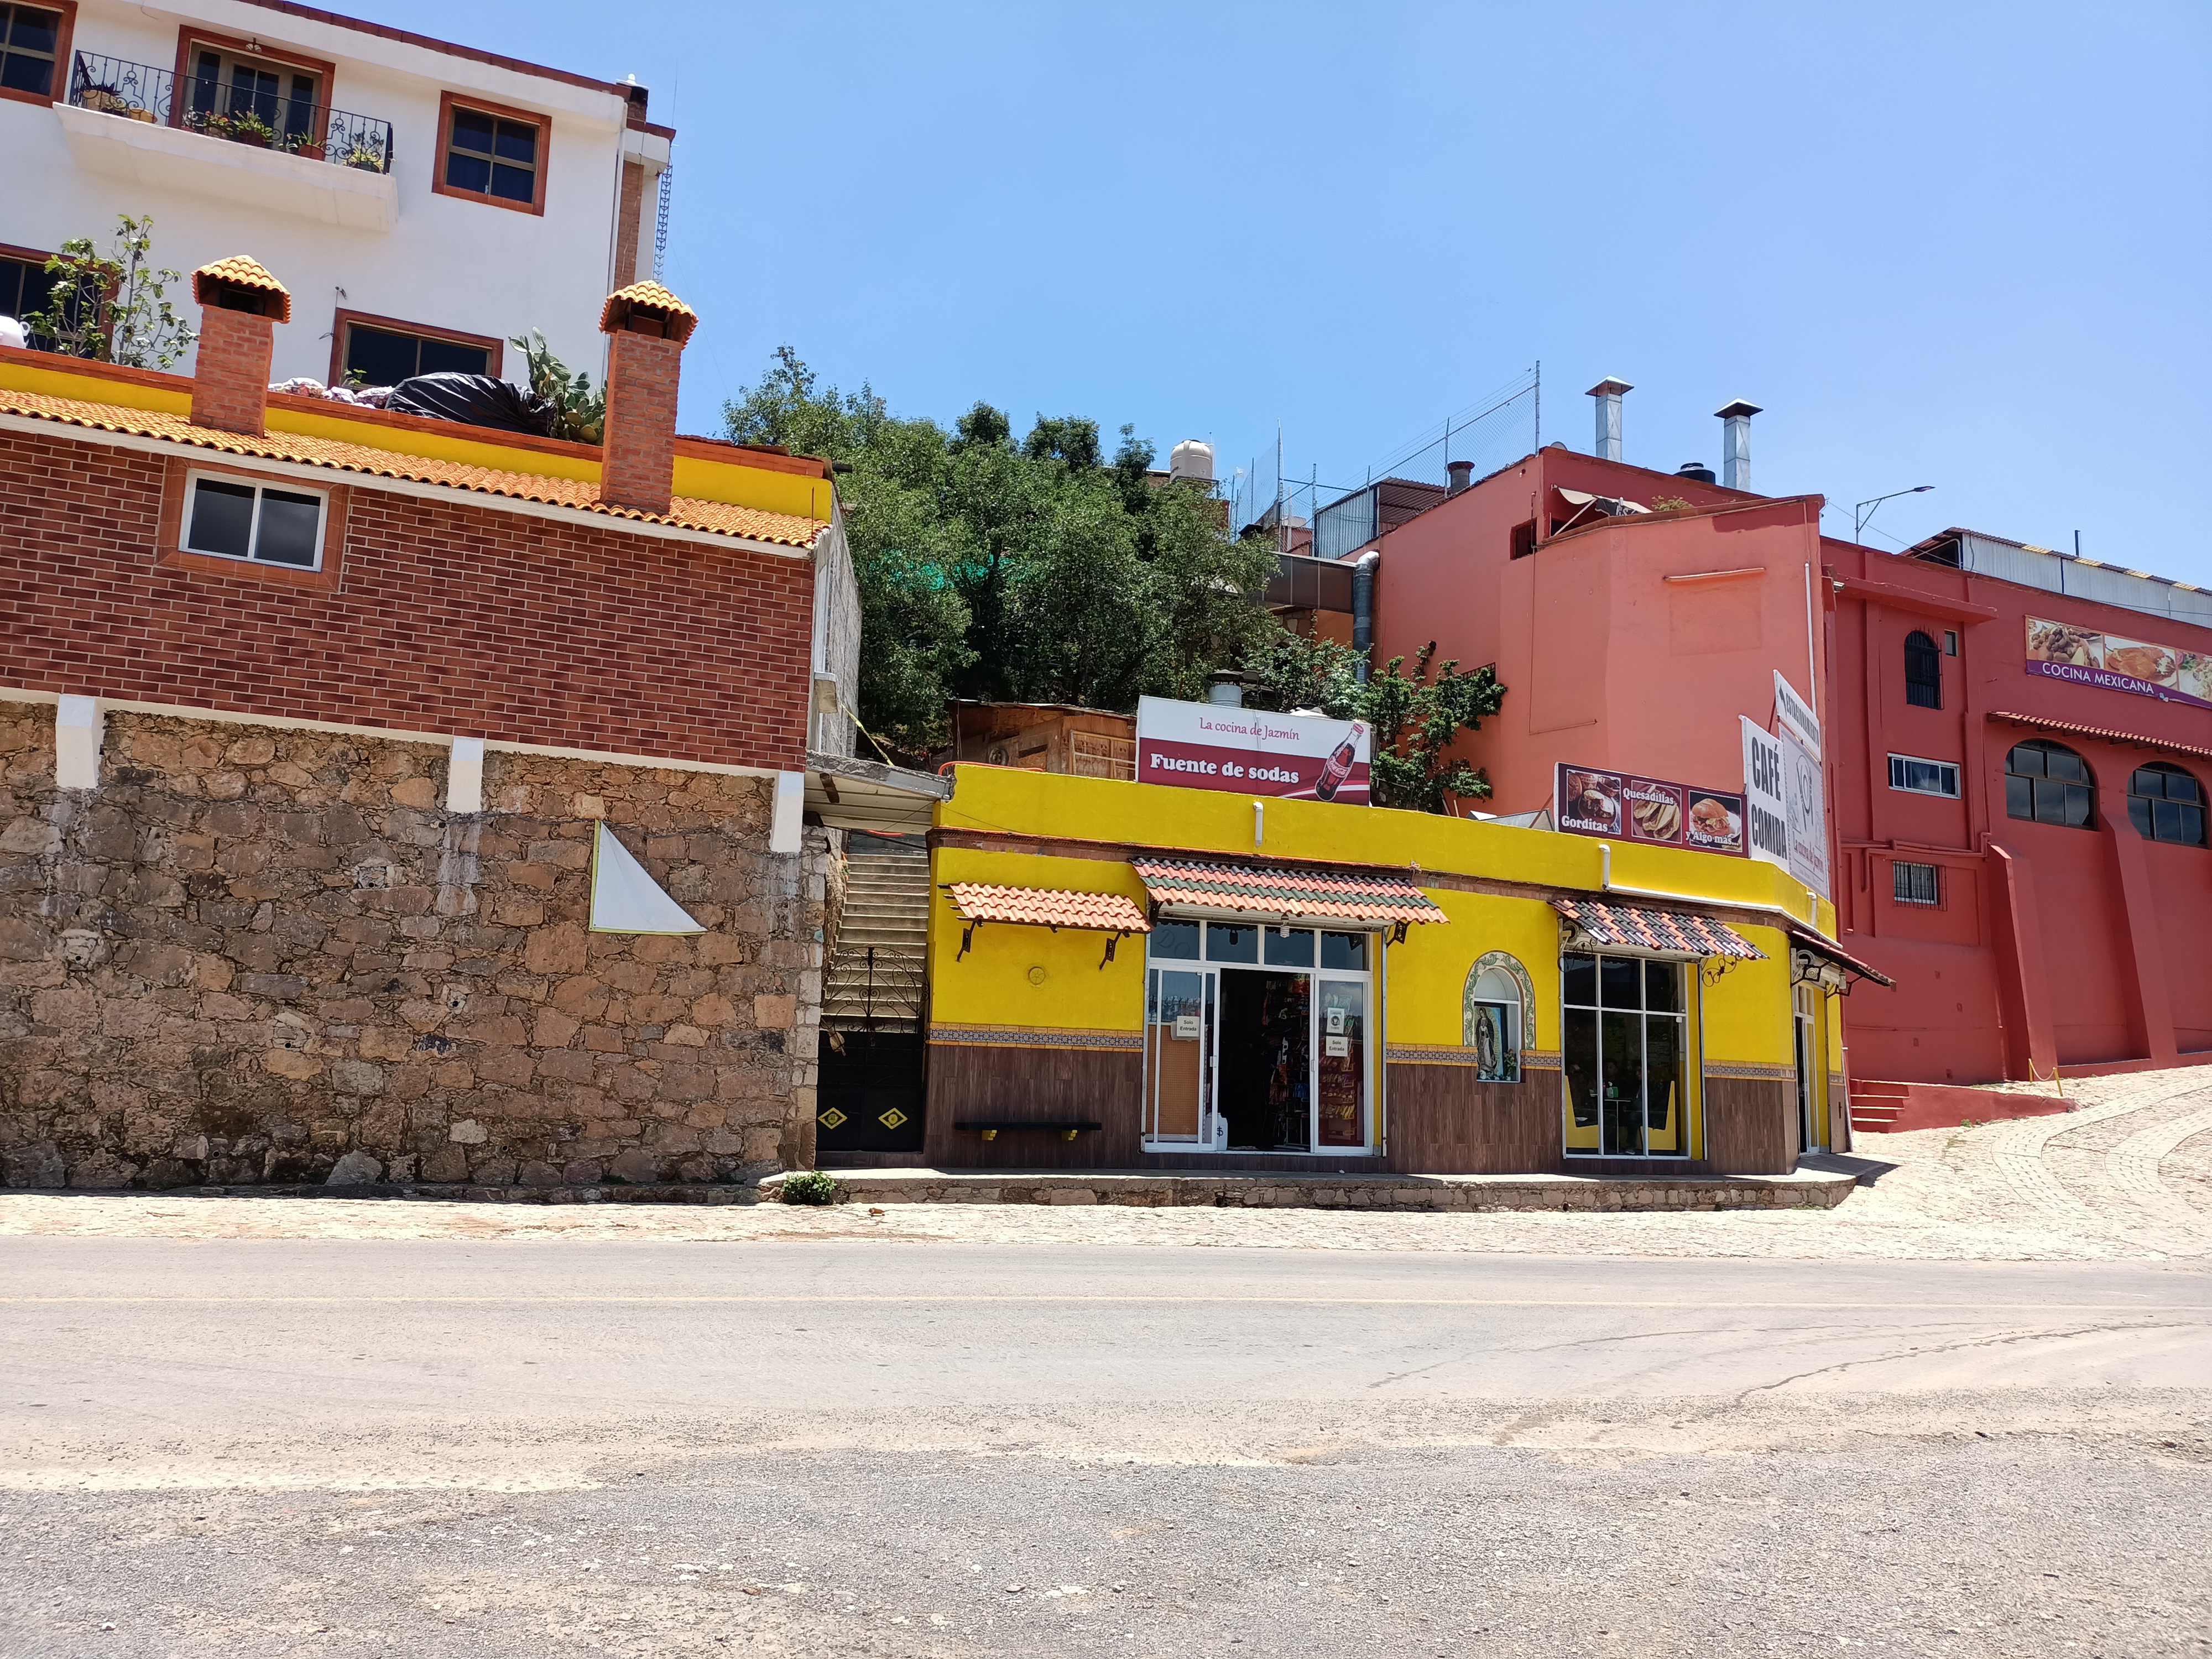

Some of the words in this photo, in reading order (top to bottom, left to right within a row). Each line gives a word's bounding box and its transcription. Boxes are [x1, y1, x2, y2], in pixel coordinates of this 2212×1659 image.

[2042, 662, 2091, 682] COCINA
[2094, 673, 2154, 693] MEXICANA
[1199, 717, 1213, 731] La
[1215, 721, 1248, 734] cocina
[1250, 722, 1262, 735] de
[1262, 725, 1300, 740] Jazmín
[1150, 753, 1217, 775] Fuente
[1222, 761, 1244, 778] de
[1248, 765, 1299, 784] sodas
[1751, 737, 1781, 801] CAFÉ
[1623, 787, 1674, 805] Quesadillas
[1561, 815, 1608, 832] Gorditas
[1685, 831, 1691, 841] y
[1693, 831, 1713, 843] Algo
[1751, 803, 1787, 860] COMIDA
